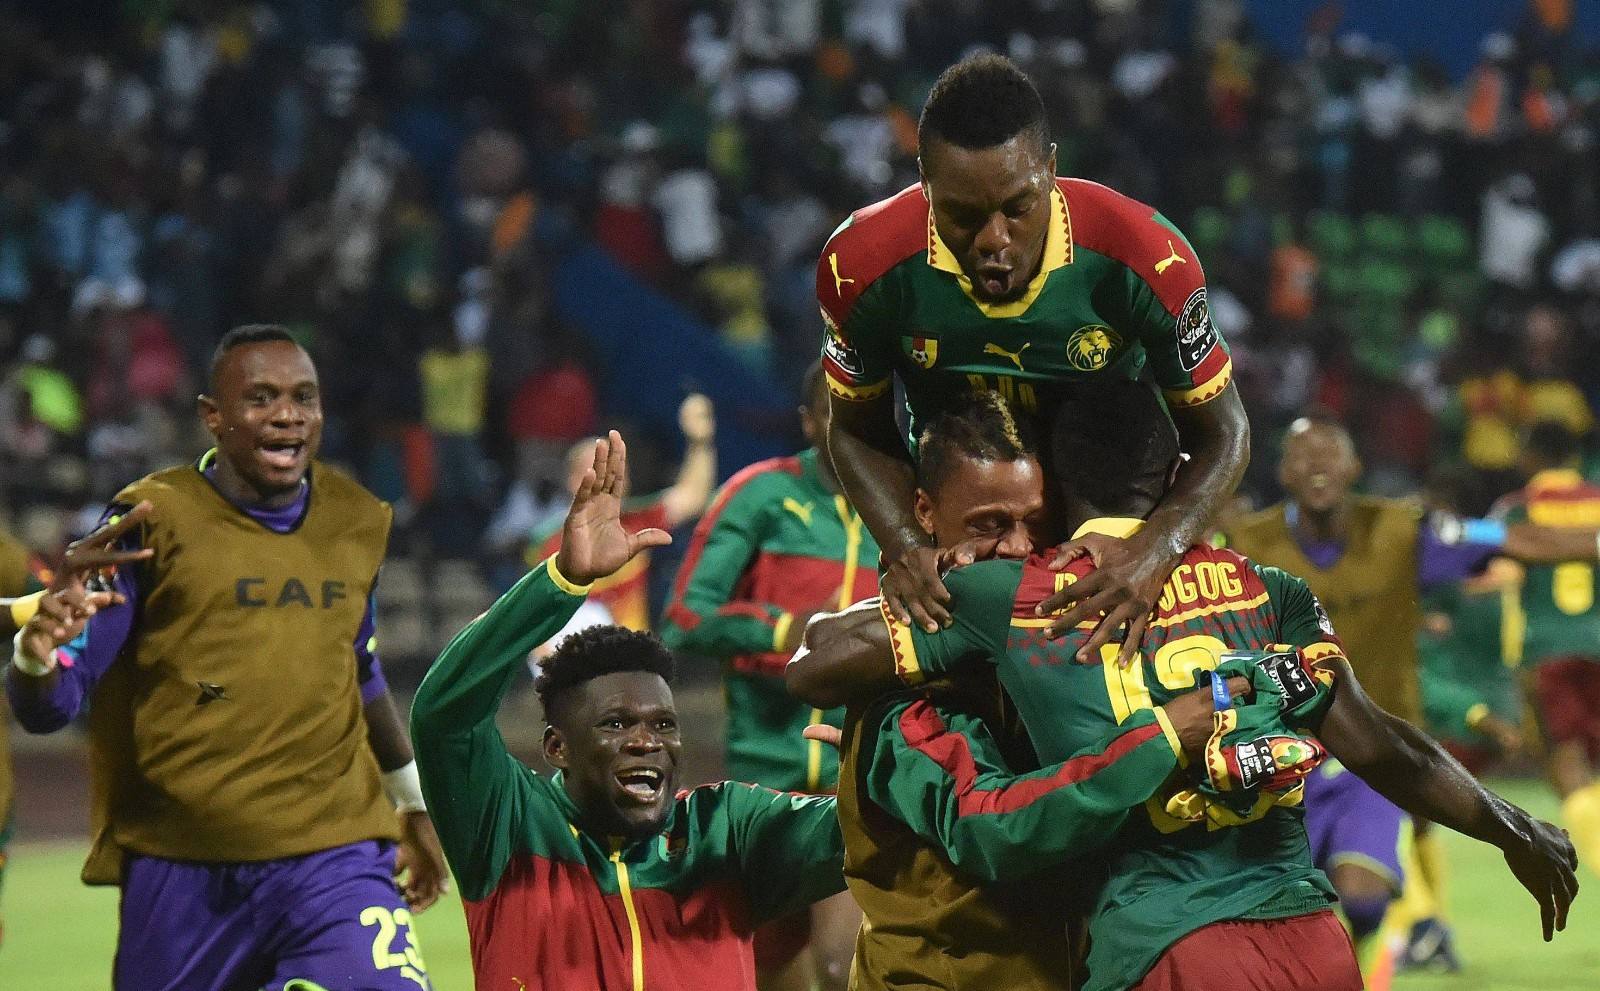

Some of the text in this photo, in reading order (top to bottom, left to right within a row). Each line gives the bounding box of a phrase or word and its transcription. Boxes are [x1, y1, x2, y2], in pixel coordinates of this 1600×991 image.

[235, 575, 347, 608] CAF
[1284, 659, 1306, 692] CAF
[1260, 745, 1276, 775] CAF
[359, 906, 426, 973] 23
